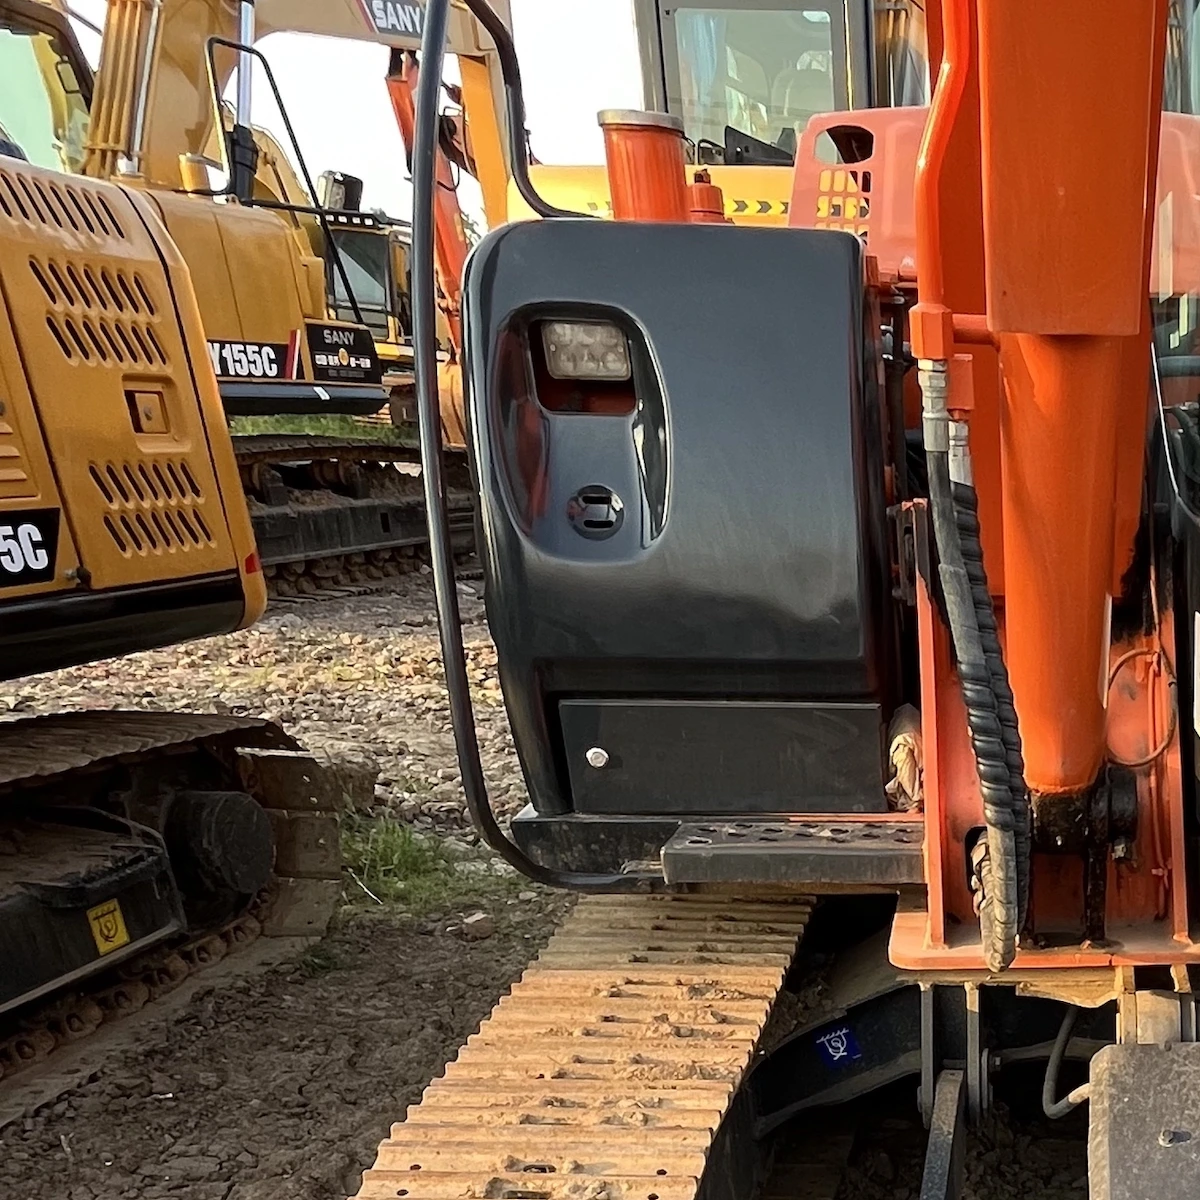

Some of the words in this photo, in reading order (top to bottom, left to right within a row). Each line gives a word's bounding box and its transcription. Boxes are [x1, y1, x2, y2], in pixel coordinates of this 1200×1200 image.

[372, 0, 421, 34] SANY
[323, 329, 356, 346] SANY
[0, 524, 48, 572] 5C
